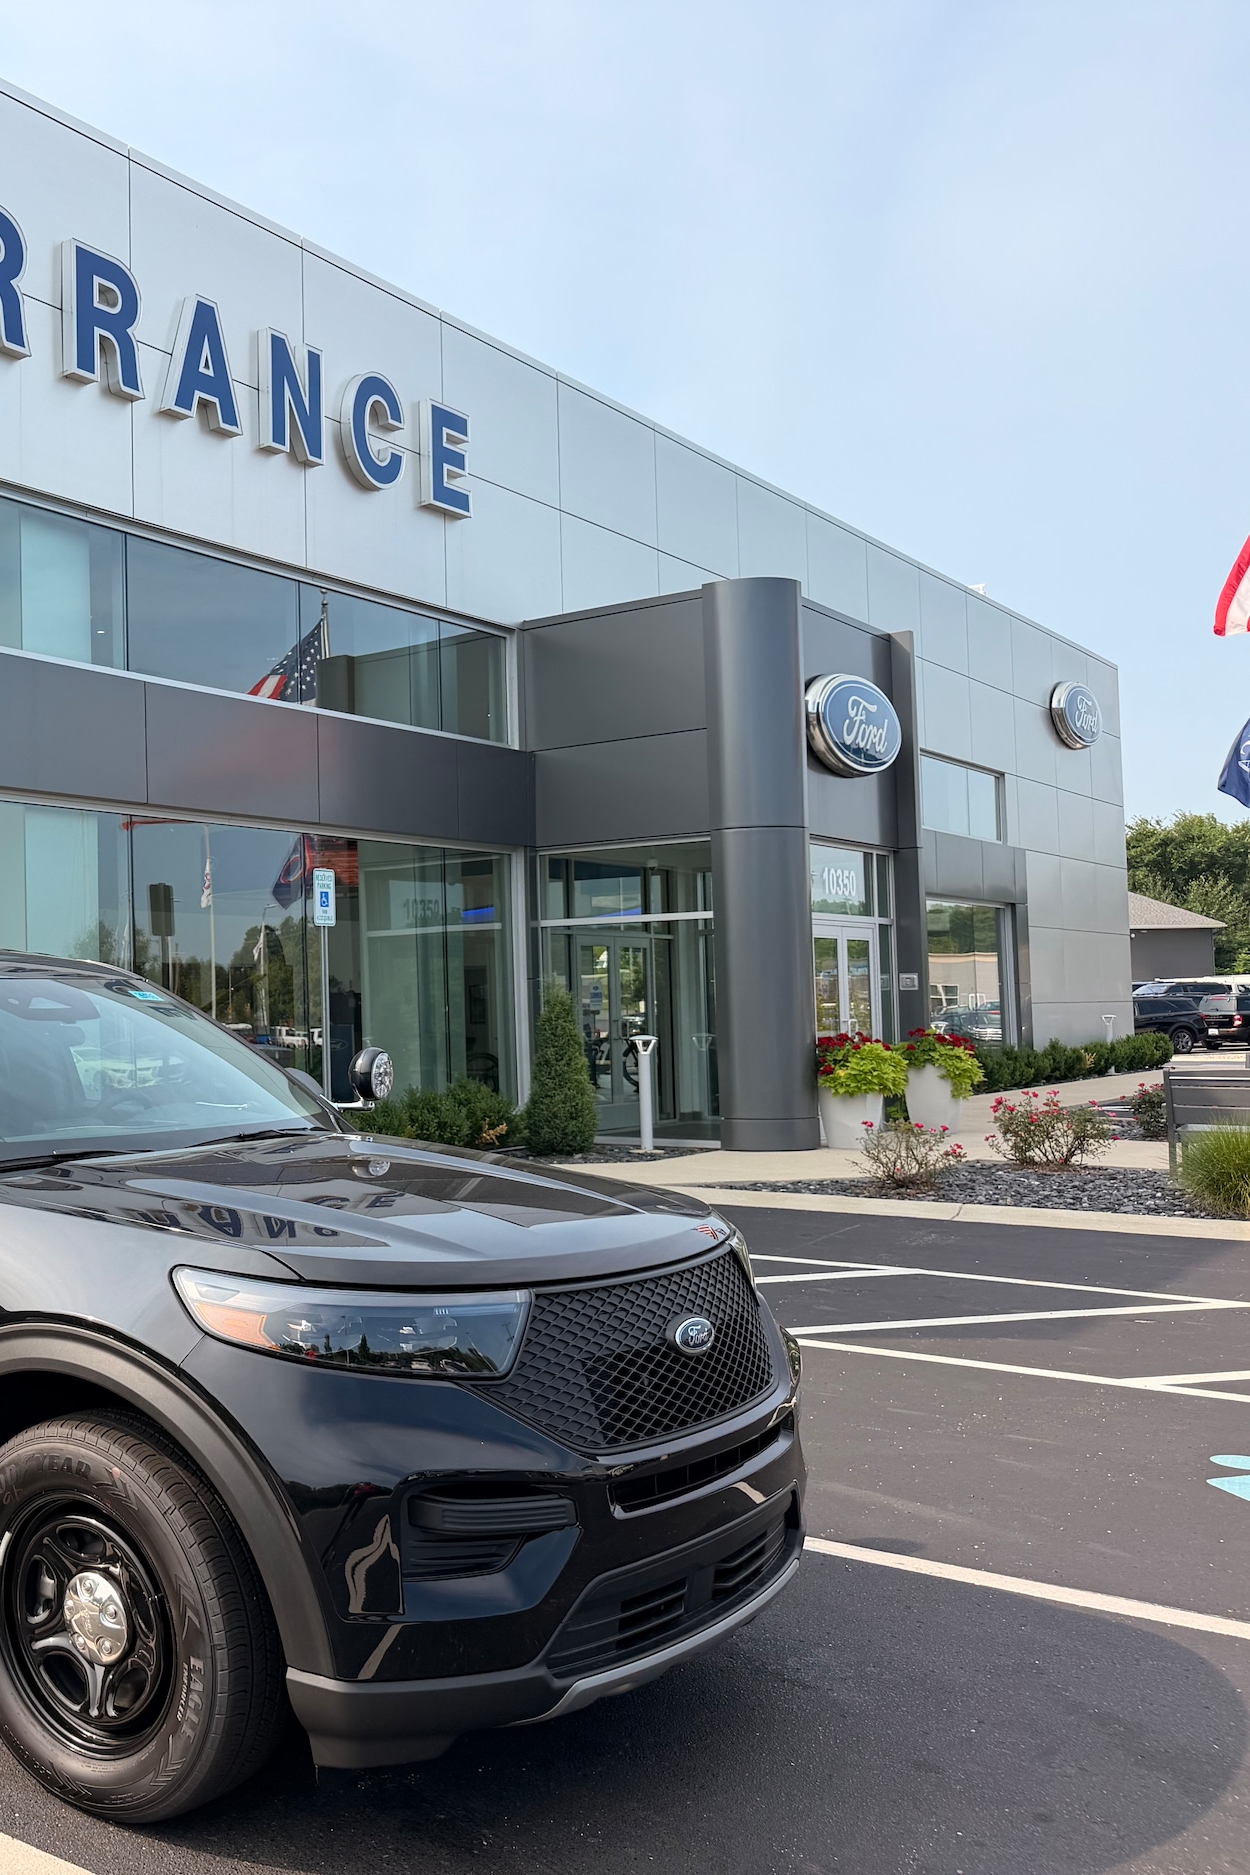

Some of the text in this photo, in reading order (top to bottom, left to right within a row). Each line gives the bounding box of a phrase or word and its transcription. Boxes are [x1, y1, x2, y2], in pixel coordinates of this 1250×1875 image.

[843, 695, 888, 754] Ford
[1075, 695, 1098, 734] Ford
[822, 867, 857, 897] 10350
[181, 1655, 204, 1744] EAGLE
